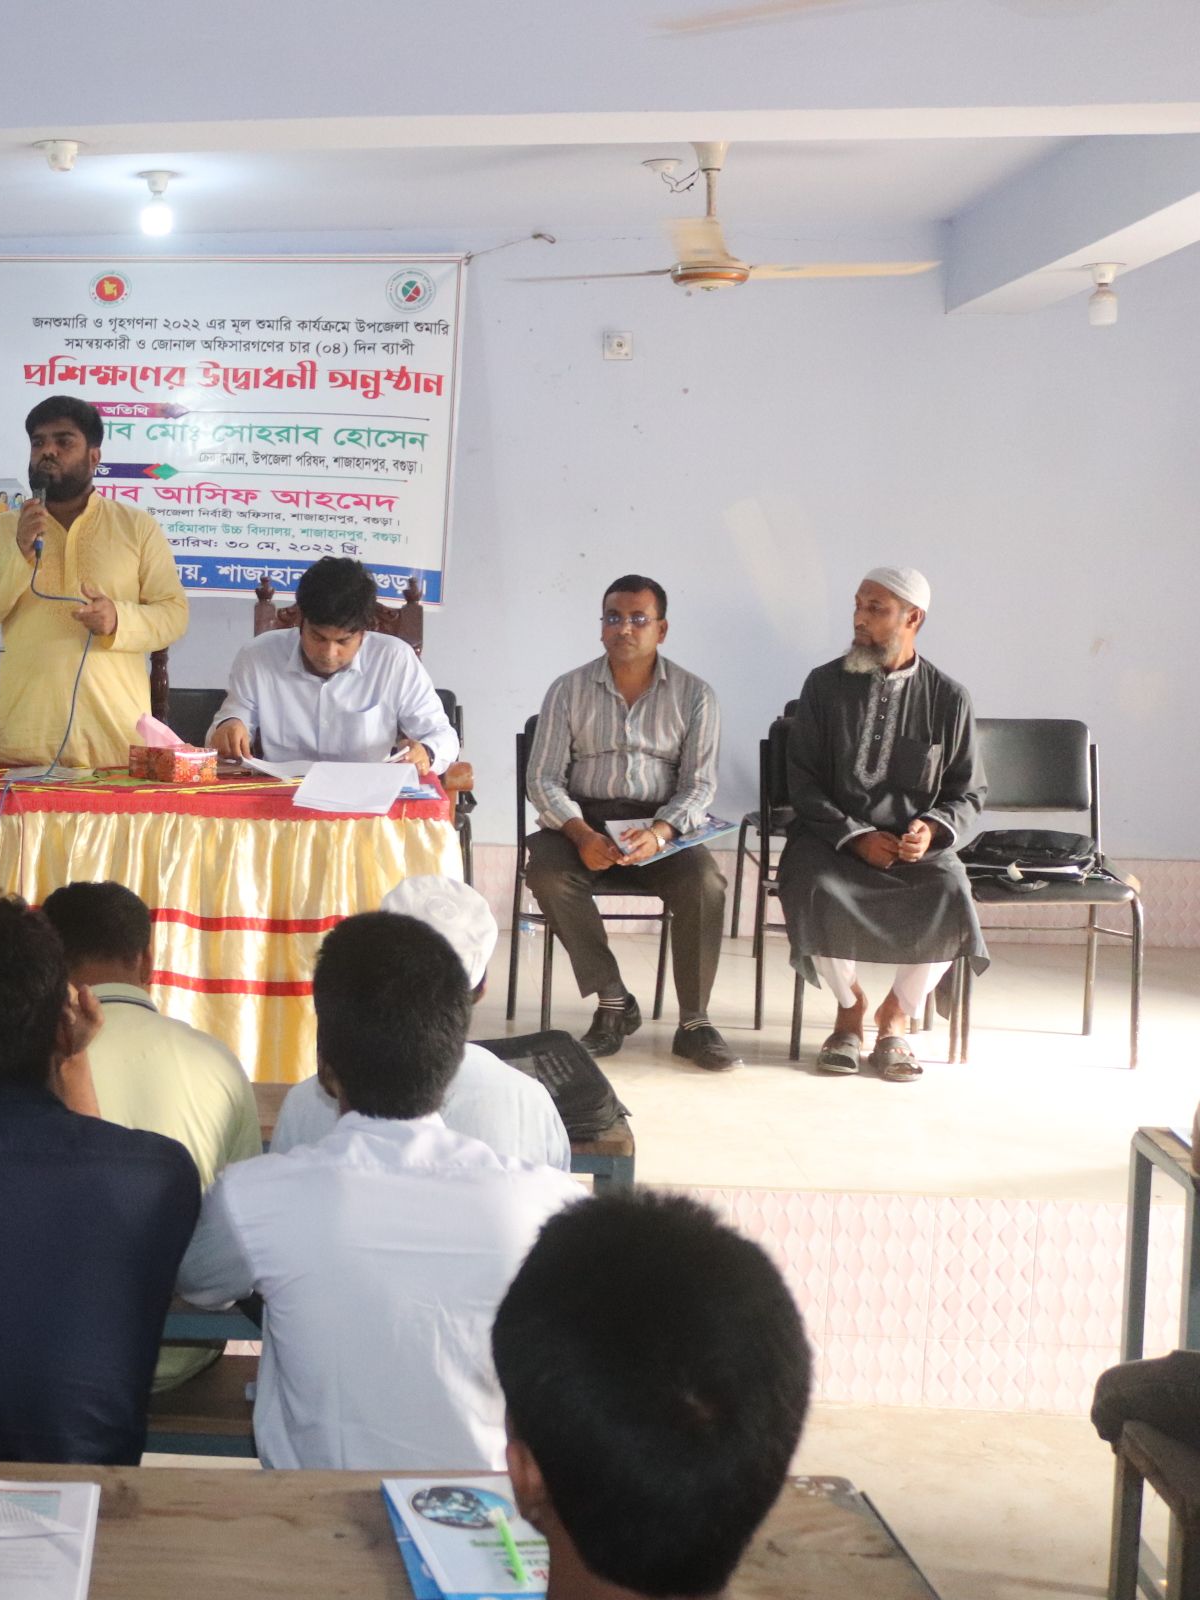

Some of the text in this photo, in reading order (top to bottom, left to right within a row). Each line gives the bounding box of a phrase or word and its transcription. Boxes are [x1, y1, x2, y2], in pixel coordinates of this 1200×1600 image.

[32, 313, 450, 336] জনশুমারি ও গৃহগণনা ২০২২ এর মূল শুমারি কার্যক্রমে উপজেলা শুমারি
[64, 334, 415, 357] সমন্বয়কারী ও জোনাল অফিসারগণের চার (০৪) দিন ব্যাপী
[23, 355, 445, 400] প্রশিক্ষণের উদ্বোধনী অনুষ্ঠান
[103, 404, 150, 416] অতিথি
[212, 423, 323, 446] সোহরাব
[334, 427, 428, 451] হোসেন
[252, 450, 291, 467] উপজেলা
[295, 451, 329, 469] পরিষদ,
[333, 455, 389, 473] শাজাহানপুর,
[153, 482, 261, 505] আসিফ
[271, 490, 399, 512] আহমেদ
[198, 508, 233, 519] নির্বাহী
[237, 509, 285, 522] অফিসার,
[290, 512, 358, 525] শাজাহানপুর,
[168, 521, 217, 534] রহিমাবাদ
[222, 523, 243, 534] উচ্চ
[247, 524, 295, 538] বিদ্যালয়,
[300, 527, 368, 542] শাজাহানপুর,
[225, 541, 249, 549] ৩০
[257, 541, 281, 552] মে,
[288, 543, 335, 553] ২০২২
